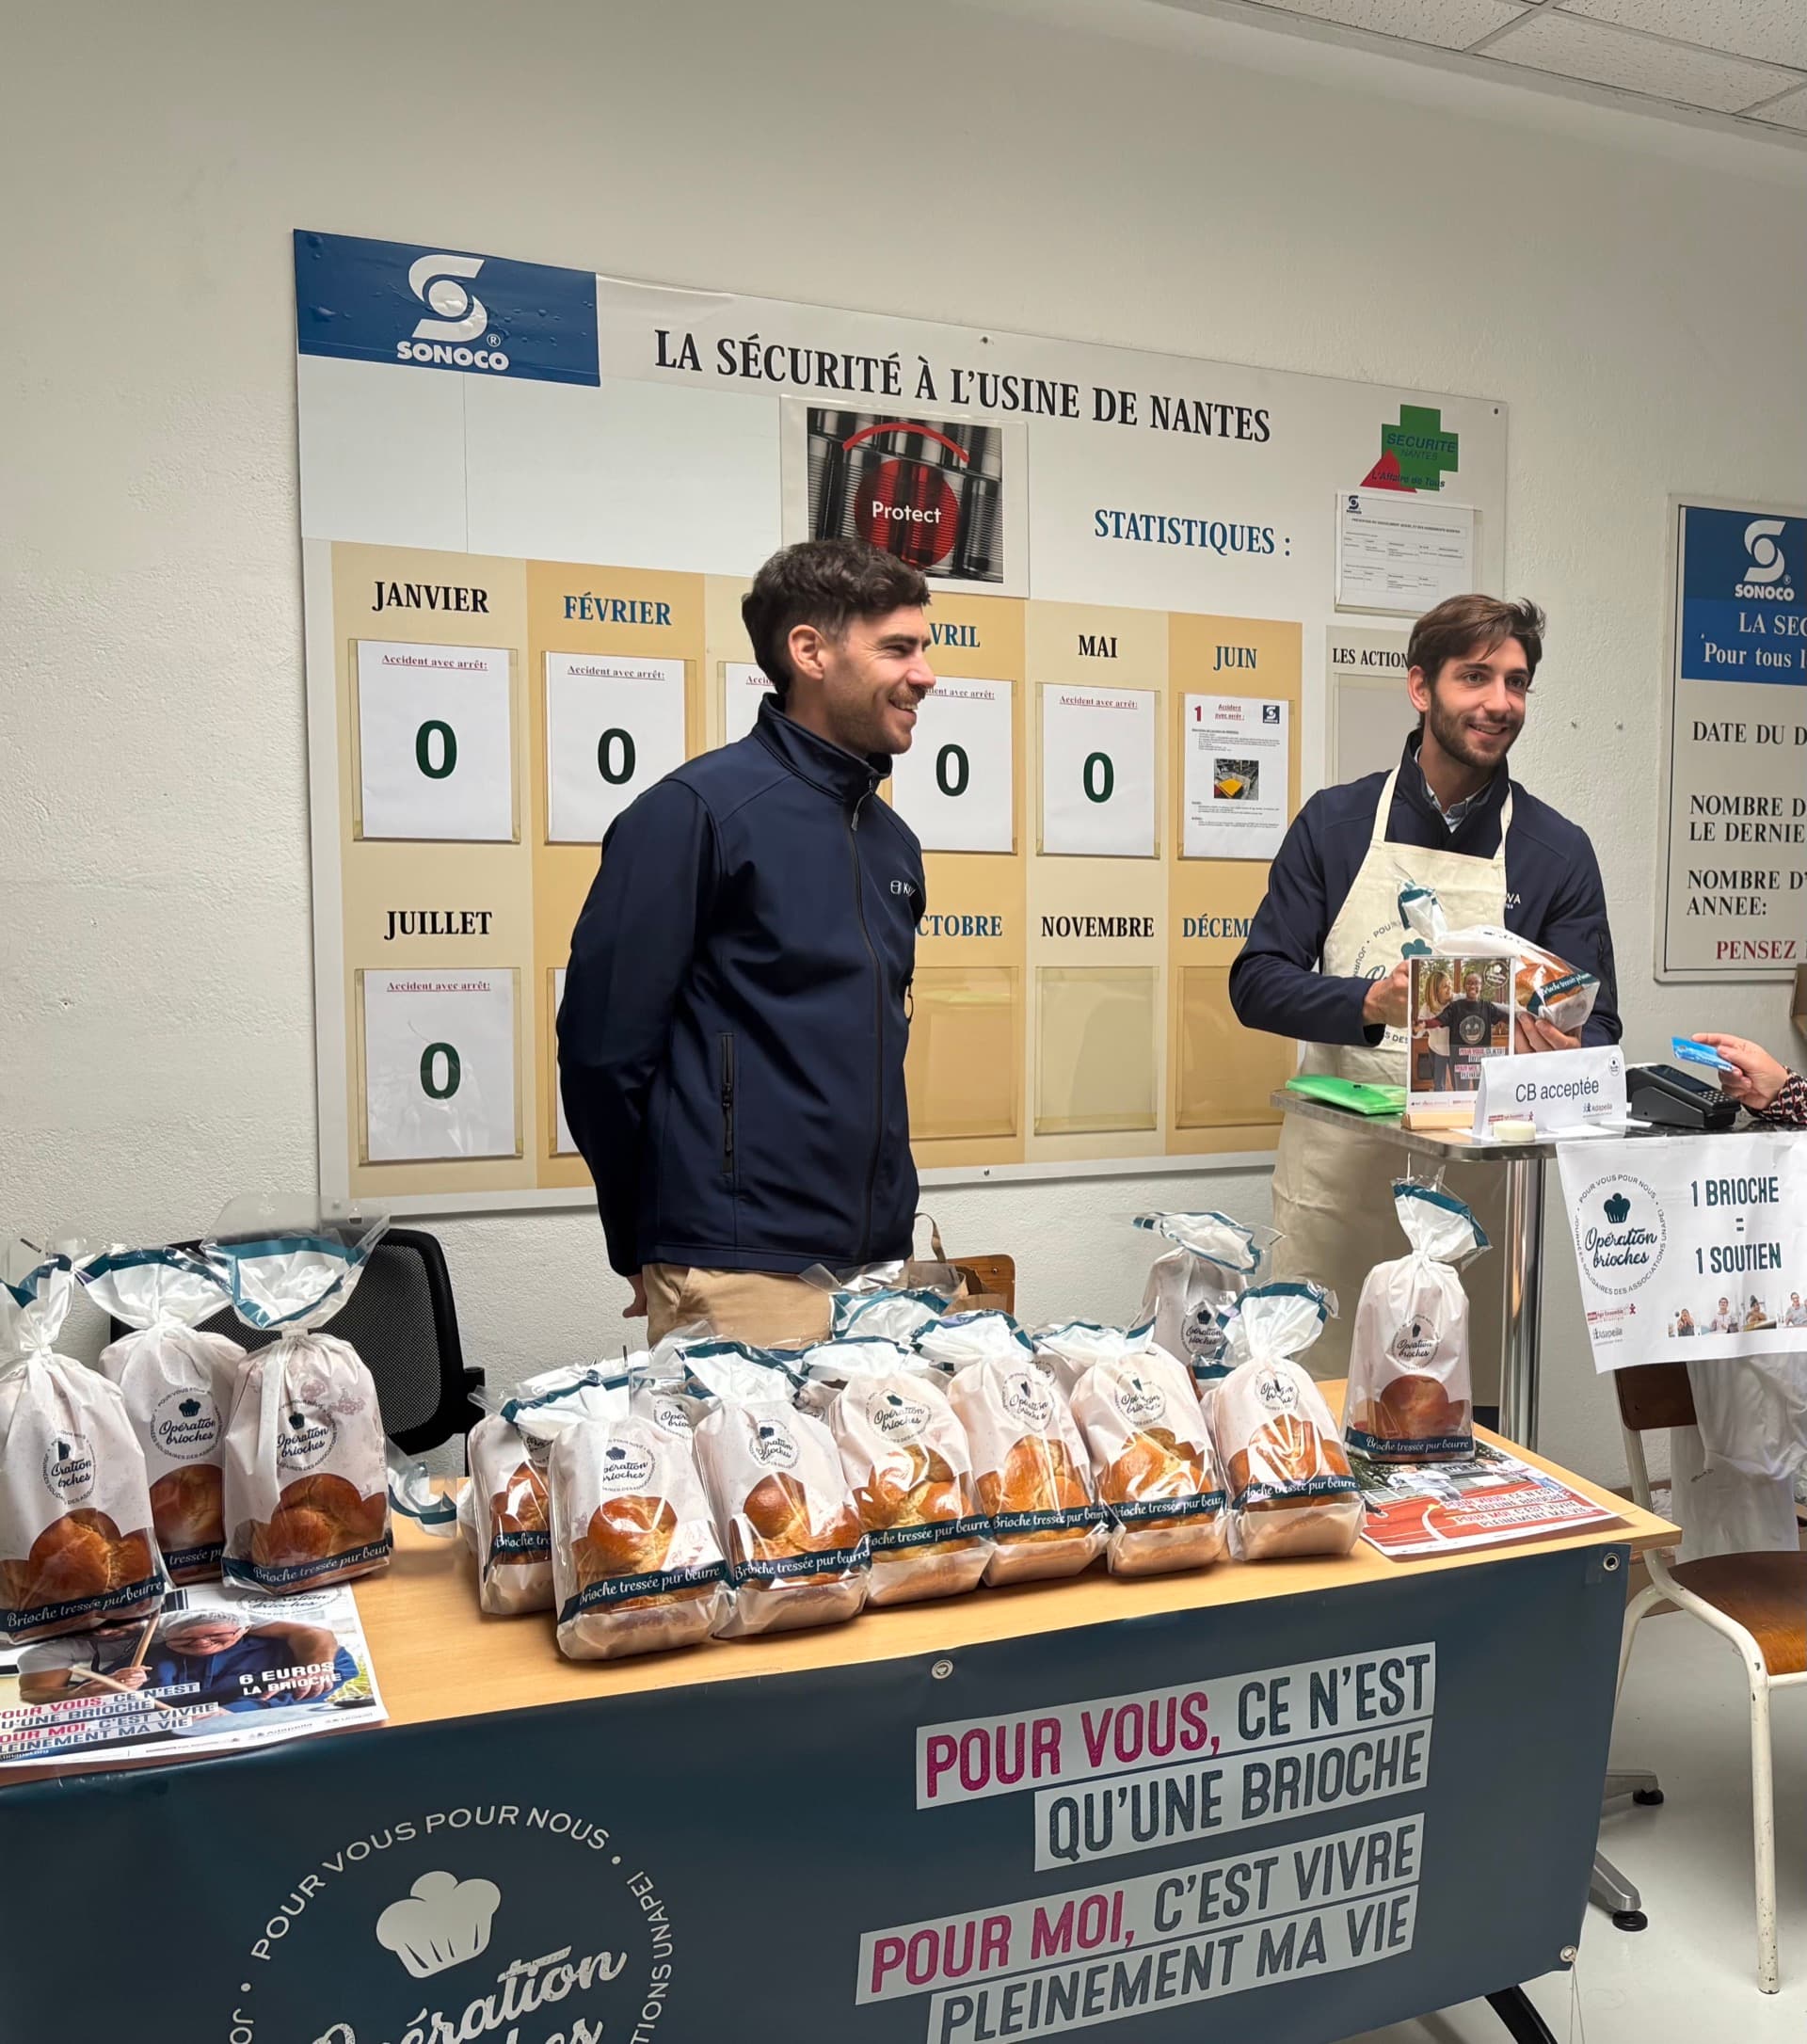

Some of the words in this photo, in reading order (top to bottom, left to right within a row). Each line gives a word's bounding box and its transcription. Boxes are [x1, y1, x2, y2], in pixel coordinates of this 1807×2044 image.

[396, 341, 509, 371] SONOCO
[655, 329, 702, 372] LA
[716, 333, 902, 396] SÉCURITÉ
[915, 355, 937, 400] À
[1092, 387, 1138, 425] DE
[1150, 395, 1270, 442] NANTES
[1387, 433, 1457, 454] SECURITE
[1400, 449, 1438, 461] NANTES
[1410, 474, 1423, 484] de
[1425, 475, 1446, 487] Tous
[872, 501, 941, 523] Protect
[1095, 509, 1275, 556] STATISTIQUES
[372, 581, 489, 614] JANVIER
[1735, 583, 1795, 602] SONOCO
[563, 592, 672, 626] FÉVRIER
[930, 623, 981, 647] VRIL
[1739, 612, 1767, 634] LA
[1078, 634, 1118, 659] MAI
[1213, 646, 1257, 671] JUIN
[1333, 647, 1355, 664] LES
[1361, 649, 1409, 668] ACTION
[1703, 642, 1747, 665] Pour
[1755, 647, 1792, 668] tous
[382, 655, 428, 666] Accident
[431, 659, 455, 668] avec
[568, 665, 610, 677] Accident
[613, 669, 634, 679] avec
[1060, 695, 1094, 706] Accident
[1095, 698, 1113, 707] avec
[1194, 706, 1202, 722] 1
[1692, 721, 1747, 743] DATE
[1756, 725, 1785, 745] DU
[1794, 726, 1807, 746] D
[415, 720, 457, 779] 0
[598, 727, 636, 785] 0
[935, 743, 969, 797] 0
[1083, 752, 1114, 803] 0
[1689, 794, 1783, 817] NOMBRE
[1791, 798, 1806, 818] D
[1689, 822, 1715, 841] LE
[1724, 822, 1806, 844] DERNIE
[1687, 870, 1780, 890] NOMBRE
[1687, 896, 1767, 916] ANNEE:
[384, 910, 492, 941] JUILLET
[917, 915, 1002, 937] CTOBRE
[1042, 916, 1155, 937] NOVEMBRE
[1182, 913, 1251, 938] DÉCEM
[1716, 940, 1797, 960] PENSEZ
[387, 982, 433, 991] Accident
[435, 983, 459, 992] avec
[420, 1042, 461, 1100] 0
[1515, 1083, 1537, 1102] CB
[1541, 1077, 1599, 1100] acceptée
[1596, 1174, 1617, 1186] VOUS
[1618, 1174, 1638, 1184] POUR
[1691, 1180, 1698, 1206] 1
[1705, 1176, 1780, 1206] BRIOCHE
[1585, 1227, 1658, 1253] Opération
[1593, 1246, 1650, 1269] brioches
[1696, 1248, 1703, 1273] 1
[1710, 1242, 1782, 1273] SOUTIEN
[1613, 1286, 1627, 1296] DES
[1366, 1436, 1394, 1451] Broche
[1426, 1442, 1441, 1454] pur
[1442, 1439, 1469, 1448] beurre
[603, 1461, 648, 1474] pération
[1309, 1480, 1326, 1495] pur
[1183, 1499, 1200, 1513] pur
[898, 1528, 934, 1543] tressée
[935, 1526, 952, 1541] pur
[956, 1519, 990, 1534] beurre
[1066, 1512, 1083, 1527] pur
[169, 1546, 209, 1565] tressée
[253, 1566, 298, 1581] Brioche
[299, 1560, 337, 1576] tressée
[339, 1553, 361, 1569] pur
[777, 1558, 814, 1573] tressée
[817, 1557, 836, 1572] pur
[838, 1548, 870, 1564] beurr
[619, 1578, 659, 1598] tressée
[662, 1573, 683, 1591] pur
[684, 1565, 720, 1581] beurre
[7, 1607, 58, 1628] Brioche
[60, 1599, 102, 1617] tressée
[103, 1594, 126, 1610] pur
[125, 1579, 163, 1599] beurre
[239, 1673, 253, 1685] 6
[262, 1662, 335, 1682] EUROS
[243, 1686, 262, 1696] LA
[267, 1672, 342, 1692] BRIOCHE
[0, 1704, 42, 1719] OUR
[113, 1692, 136, 1703] CE
[144, 1684, 199, 1698] N'EST
[0, 1730, 40, 1743] OUR
[99, 1714, 151, 1729] C'EST
[158, 1702, 217, 1720] VIVRE
[1, 1714, 61, 1730] U'UNE
[69, 1700, 152, 1720] BRIOCHE
[925, 1715, 1062, 1798] POUR
[1080, 1691, 1221, 1769] VOUS,
[1238, 1677, 1290, 1741] CE
[1309, 1653, 1431, 1730] N'EST
[0, 1730, 113, 1753] LEINEMENT
[119, 1724, 150, 1736] MA
[157, 1719, 189, 1730] VIE
[1048, 1769, 1223, 1862] QU'UNE
[1240, 1729, 1426, 1820] BRIOCHE
[250, 1873, 326, 1961] POUR
[322, 1821, 417, 1873] VOUS
[425, 1805, 520, 1834] POUR
[525, 1807, 610, 1851] NOUS
[871, 1914, 1012, 1994] POUR
[1031, 1890, 1135, 1962] MOI,
[1153, 1856, 1279, 1933] C'EST
[1293, 1824, 1416, 1902] VIVRE
[940, 1936, 1243, 2044] PLEINEMENT
[1255, 1917, 1327, 1978] MA
[1346, 1895, 1412, 1958] VIE
